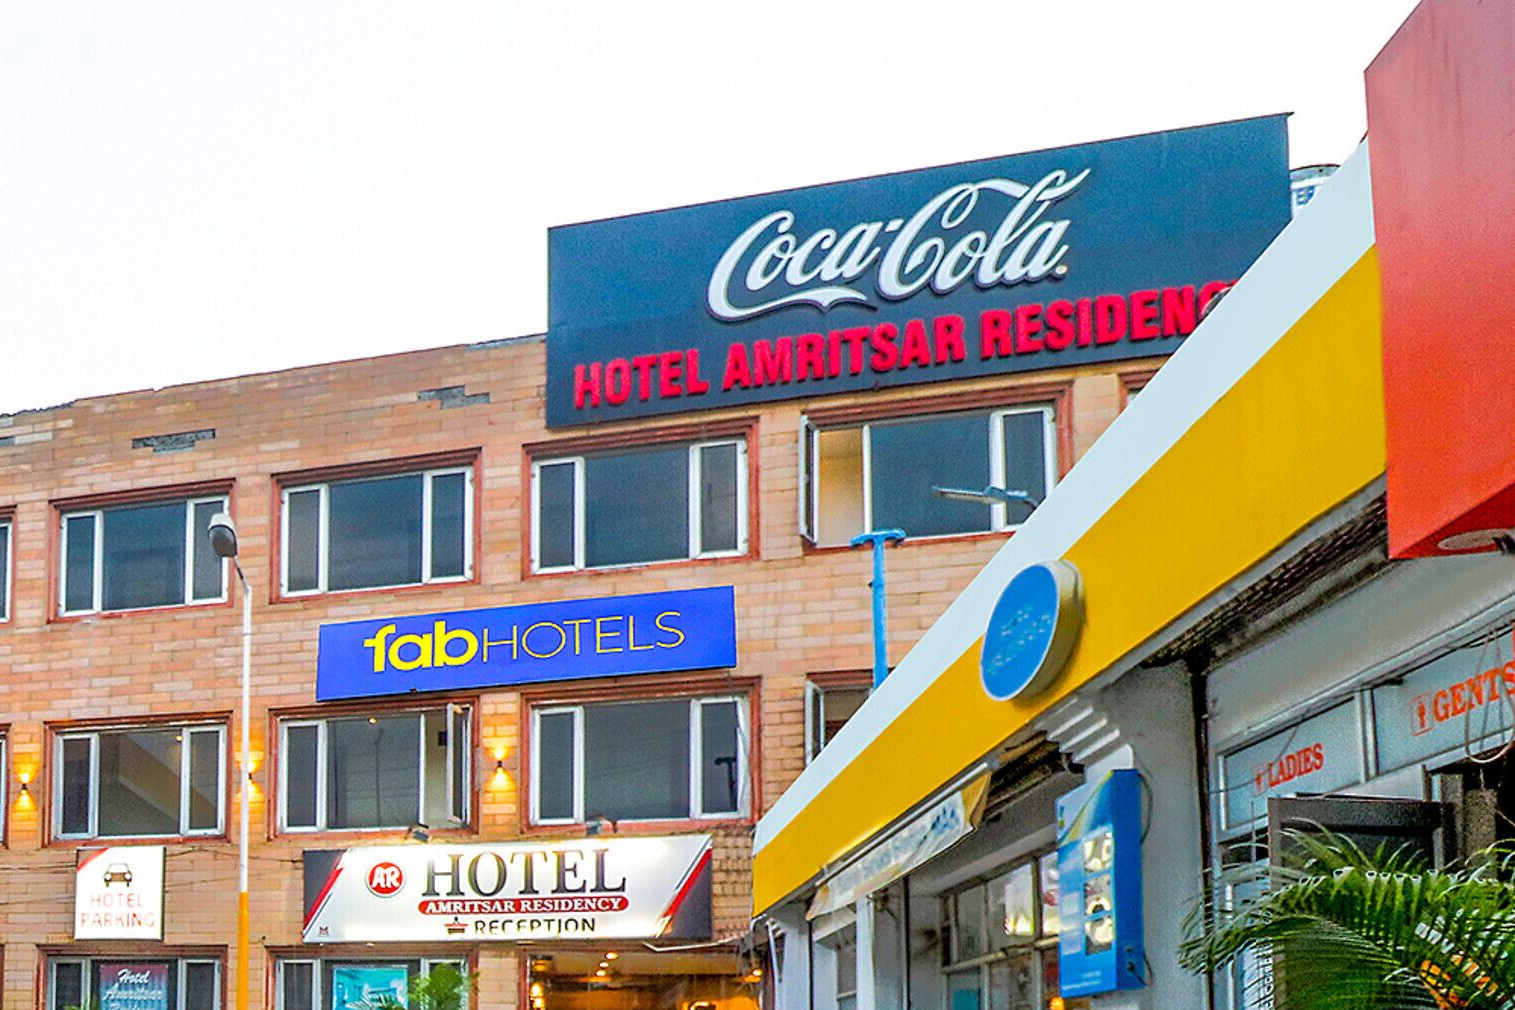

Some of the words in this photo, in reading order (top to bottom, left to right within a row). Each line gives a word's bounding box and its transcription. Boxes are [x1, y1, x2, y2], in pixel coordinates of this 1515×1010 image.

[573, 347, 710, 410] HOTEL
[722, 313, 966, 392] AMRITSAR
[1433, 660, 1515, 723] GENTS
[1268, 742, 1324, 788] LADIES
[369, 864, 403, 890] AR
[421, 847, 627, 898] HOTEL
[91, 893, 144, 908] HOTEL
[425, 899, 516, 914] AMRITSAR
[519, 896, 622, 912] RESIDENCY
[81, 912, 155, 928] PARKING
[474, 917, 596, 935] RECEPTION
